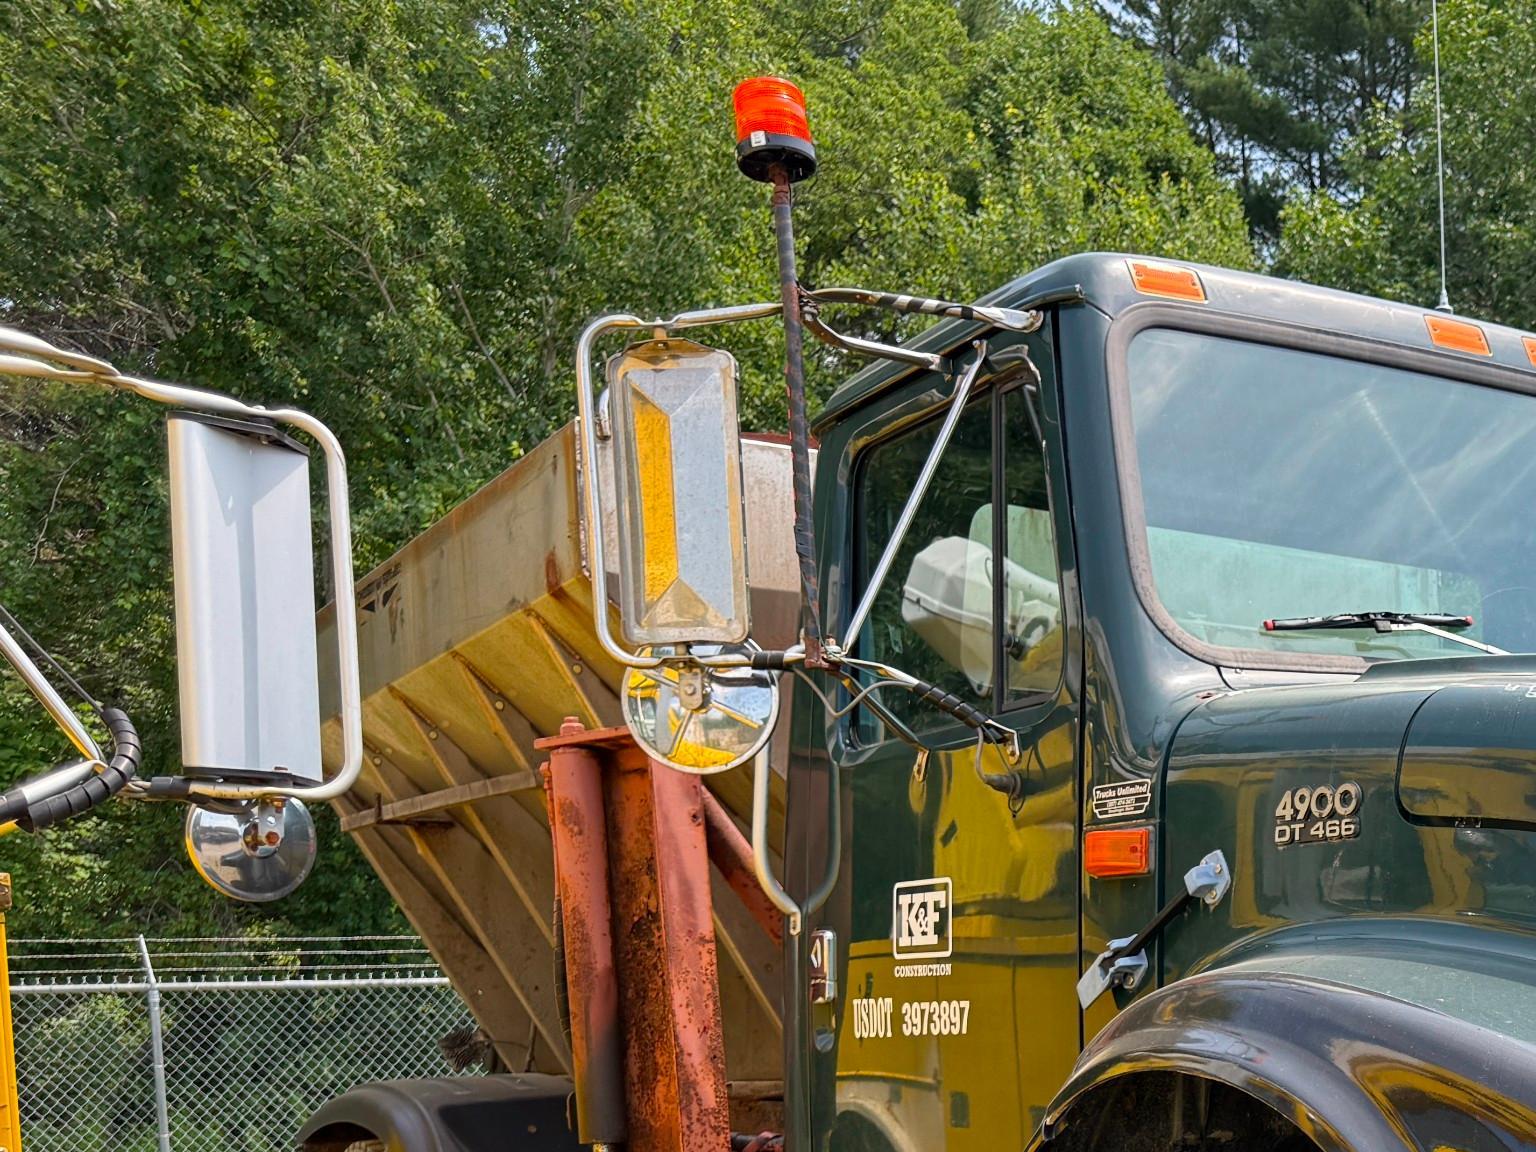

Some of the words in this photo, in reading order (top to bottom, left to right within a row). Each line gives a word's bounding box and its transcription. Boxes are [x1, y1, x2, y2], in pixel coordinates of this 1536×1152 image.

[1095, 789, 1116, 799] Trucks
[1117, 784, 1147, 796] Unlimited
[1275, 782, 1361, 820] 4900
[1275, 823, 1305, 843] DT
[1310, 818, 1356, 838] 466
[898, 890, 946, 947] K&F
[894, 963, 952, 978] CONSTRUCTION
[853, 997, 893, 1039] USDOT
[902, 1001, 970, 1037] 3973897
